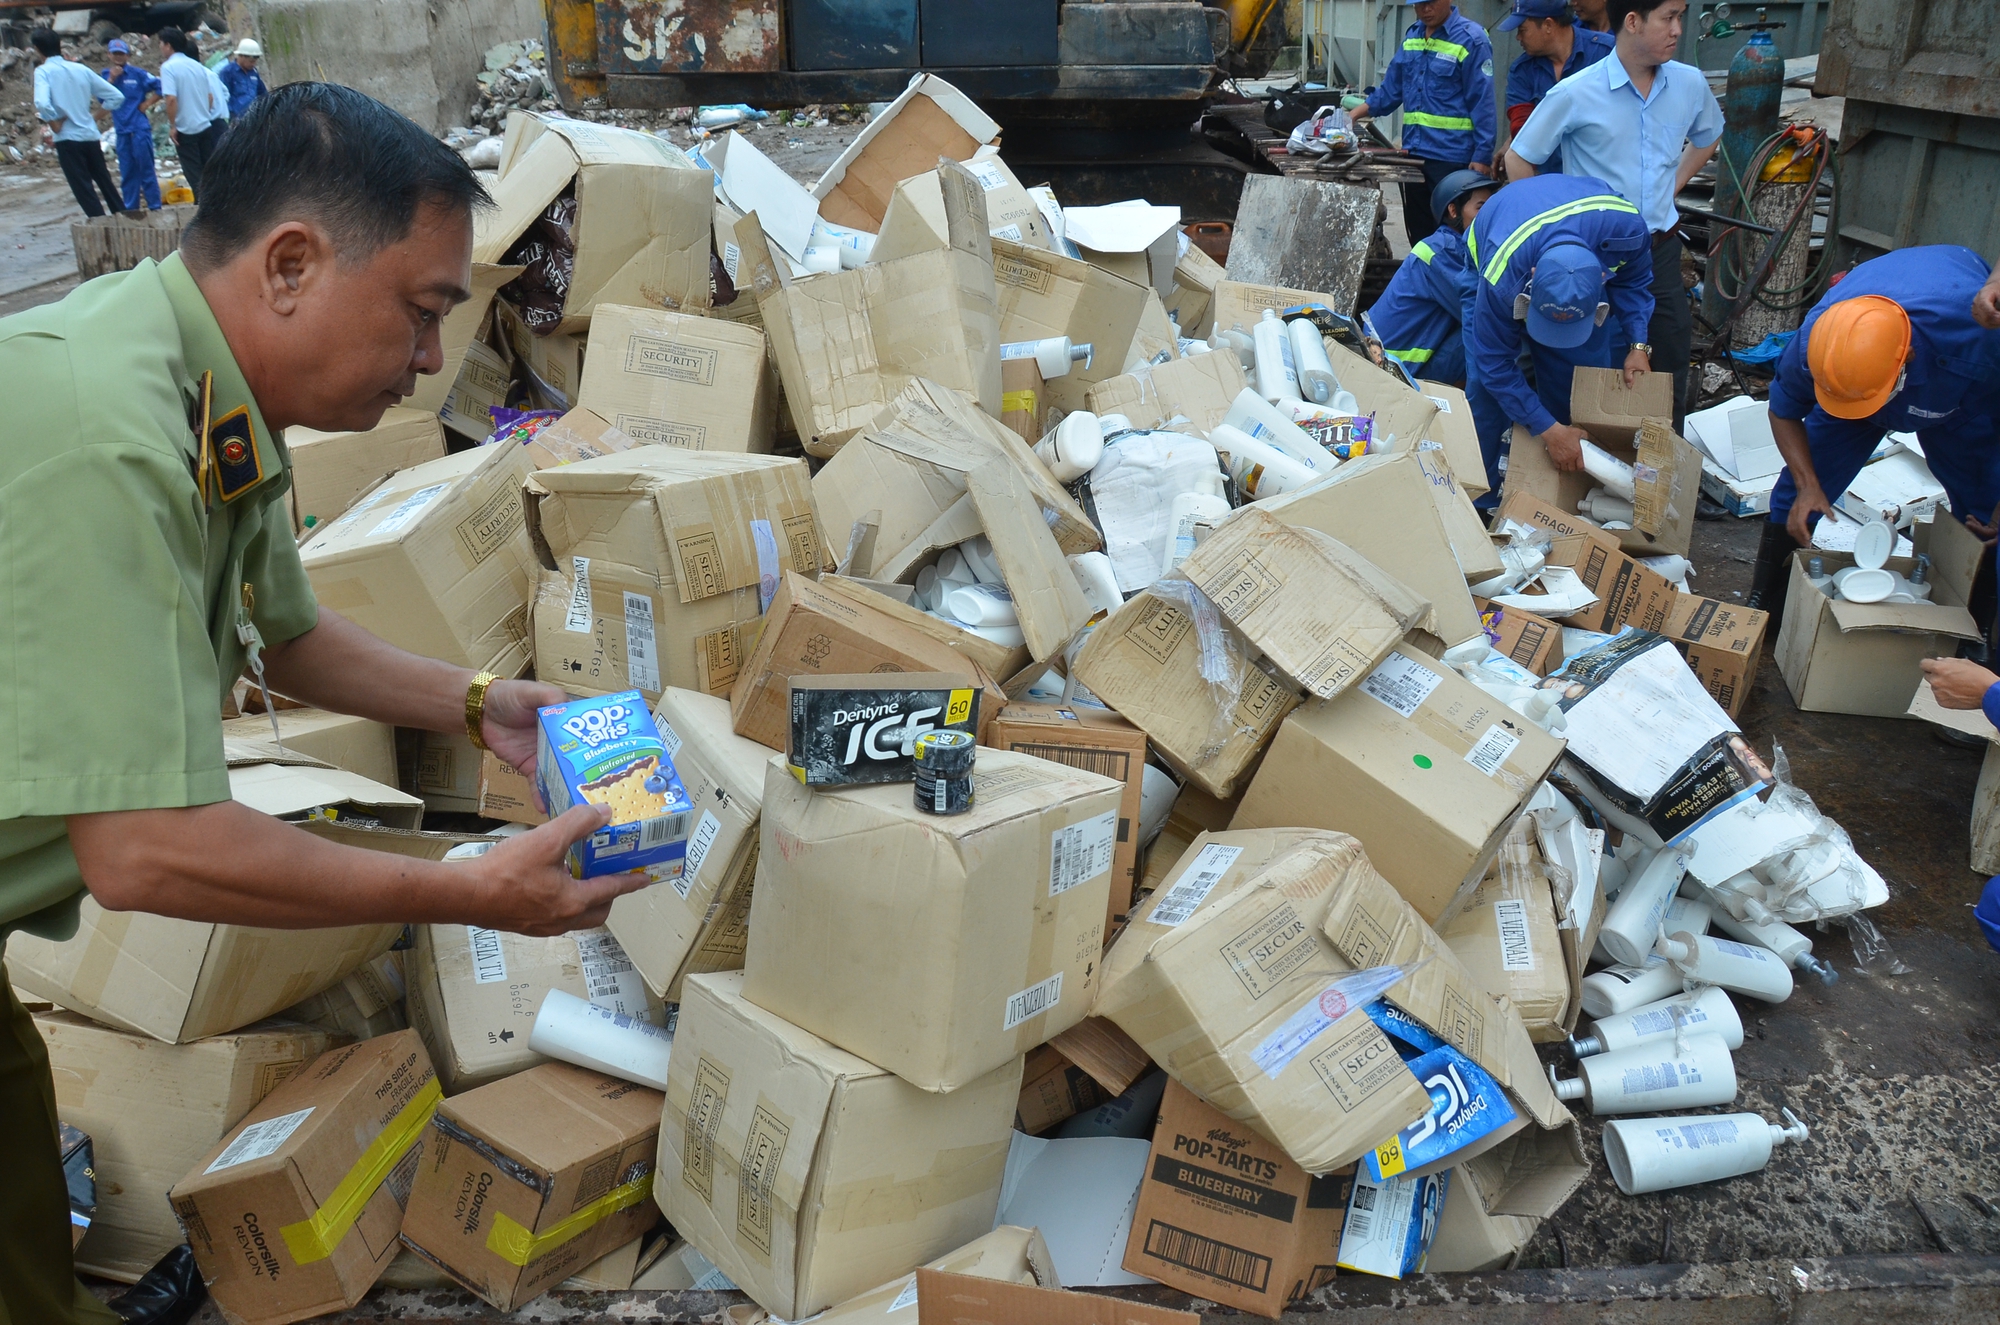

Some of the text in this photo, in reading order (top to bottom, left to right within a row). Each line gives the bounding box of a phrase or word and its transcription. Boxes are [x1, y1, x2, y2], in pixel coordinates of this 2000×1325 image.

[999, 262, 1040, 280] SECURITY
[1255, 297, 1296, 308] SECURITY
[1324, 326, 1350, 334] LEADING
[642, 350, 700, 369] SECURITY
[630, 428, 689, 446] SECURITY
[478, 498, 519, 541] SECURITY
[787, 518, 810, 528] WARNING
[683, 537, 711, 549] WARNING
[699, 555, 716, 595] SECU
[1245, 555, 1274, 587] WARNING
[1607, 573, 1628, 619] BLUEBERRY
[1618, 571, 1643, 629] POP-TARTS
[1708, 610, 1731, 638] POP-TARTS
[589, 617, 604, 677] 59121N
[720, 629, 732, 663] RITY
[803, 653, 820, 665] PLEASE
[1132, 630, 1164, 658] WARNING
[562, 658, 569, 671] UP
[800, 657, 821, 670] RECYCLE
[832, 701, 899, 727] Dentyne
[947, 712, 966, 723] PIECES
[949, 700, 968, 715] 60
[582, 738, 638, 762] Blueberry
[843, 706, 943, 766] ICE
[598, 751, 636, 774] Unfrosted
[662, 791, 677, 805] 8
[721, 794, 733, 810] UP
[1663, 775, 1718, 820] EVERY WASH
[1678, 796, 1702, 817] HAIR
[674, 838, 710, 896] VIETNAM
[1254, 920, 1306, 963] SECUR
[1359, 912, 1388, 944] WARNING
[1501, 919, 1529, 966] VIETNAM
[1083, 978, 1091, 989] UP
[1229, 951, 1258, 989] WARNING
[509, 984, 524, 1016] 76350
[488, 1031, 498, 1045] UP
[1345, 1037, 1389, 1074] SECU
[374, 1052, 417, 1100] THIS SIDE UP
[390, 1072, 415, 1101] FRAGILE
[702, 1066, 726, 1086] WARNING
[1320, 1062, 1349, 1102] WARNING
[379, 1066, 434, 1128] HANDLE WITH CARE
[1405, 1061, 1472, 1153] ICE
[1445, 1090, 1489, 1135] Dentyne
[694, 1088, 713, 1169] SECURITY
[759, 1113, 784, 1137] WARNING
[1206, 1128, 1250, 1150] Kellogg's
[1172, 1133, 1279, 1181] POP-TARTS
[1379, 1144, 1401, 1167] 60
[749, 1137, 769, 1221] SECURITY
[1177, 1167, 1265, 1207] BLUEBERRY
[453, 1170, 476, 1222] REVLON
[462, 1171, 494, 1237] Colorsilk
[232, 1224, 264, 1276] REVLON
[243, 1212, 280, 1282] Colorsilk
[526, 1274, 541, 1288] UP
